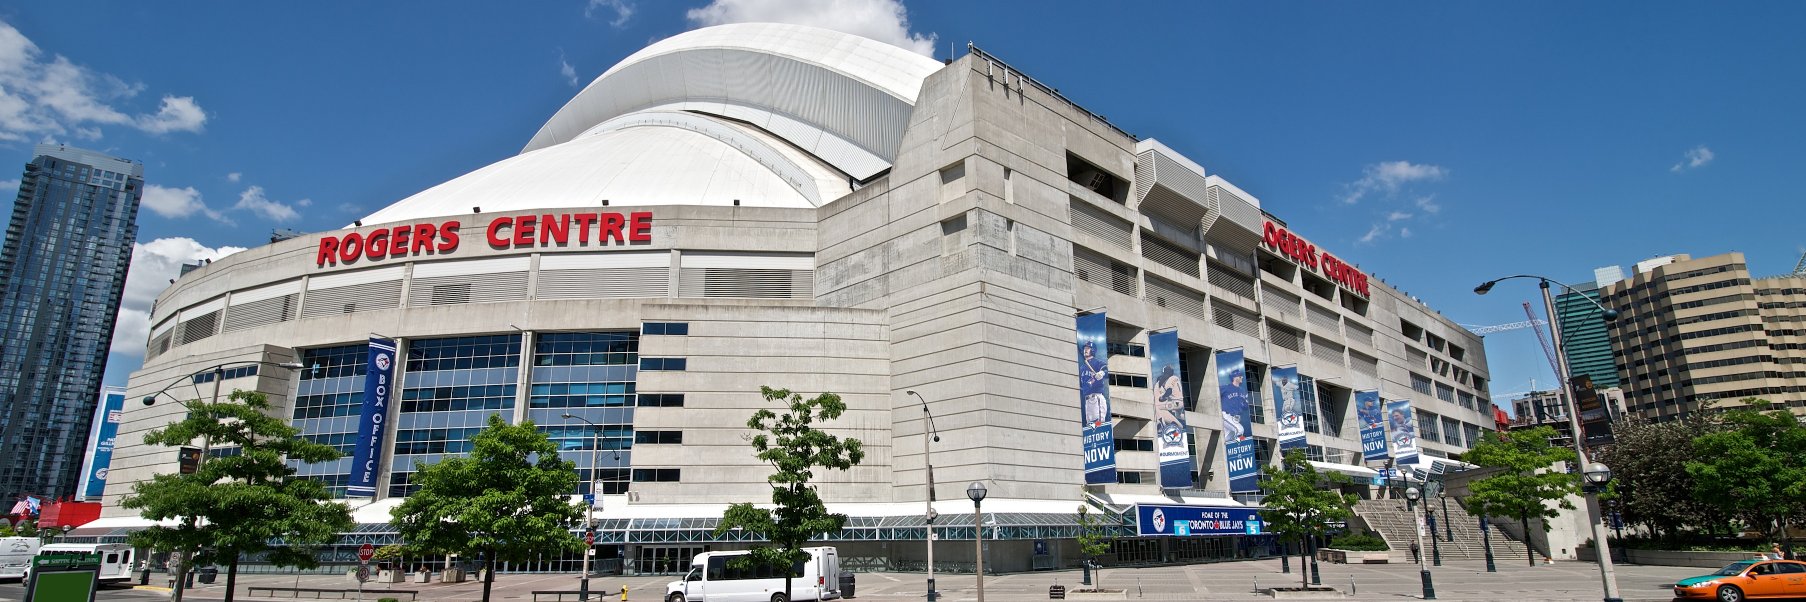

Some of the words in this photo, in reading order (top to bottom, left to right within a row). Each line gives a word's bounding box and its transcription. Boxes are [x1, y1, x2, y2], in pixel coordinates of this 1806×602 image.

[317, 220, 461, 266] ROGERS
[486, 211, 653, 248] CENTRE
[1263, 221, 1318, 268] OGERS
[1321, 252, 1370, 297] CENTRE
[375, 374, 386, 408] BOX
[1084, 430, 1110, 445] HISTORY
[1361, 430, 1383, 440] HISTORY
[362, 413, 383, 483] OFFICE
[1227, 444, 1252, 456] HISTORY
[1363, 439, 1384, 452] NOW
[1084, 445, 1111, 464] NOW
[1229, 456, 1253, 473] NOW
[1201, 511, 1214, 519] HOME
[1179, 526, 1186, 536] 6
[1219, 520, 1231, 530] BLUE
[1232, 520, 1244, 530] JAYS
[1250, 525, 1257, 535] 5
[360, 548, 374, 556] STOP
